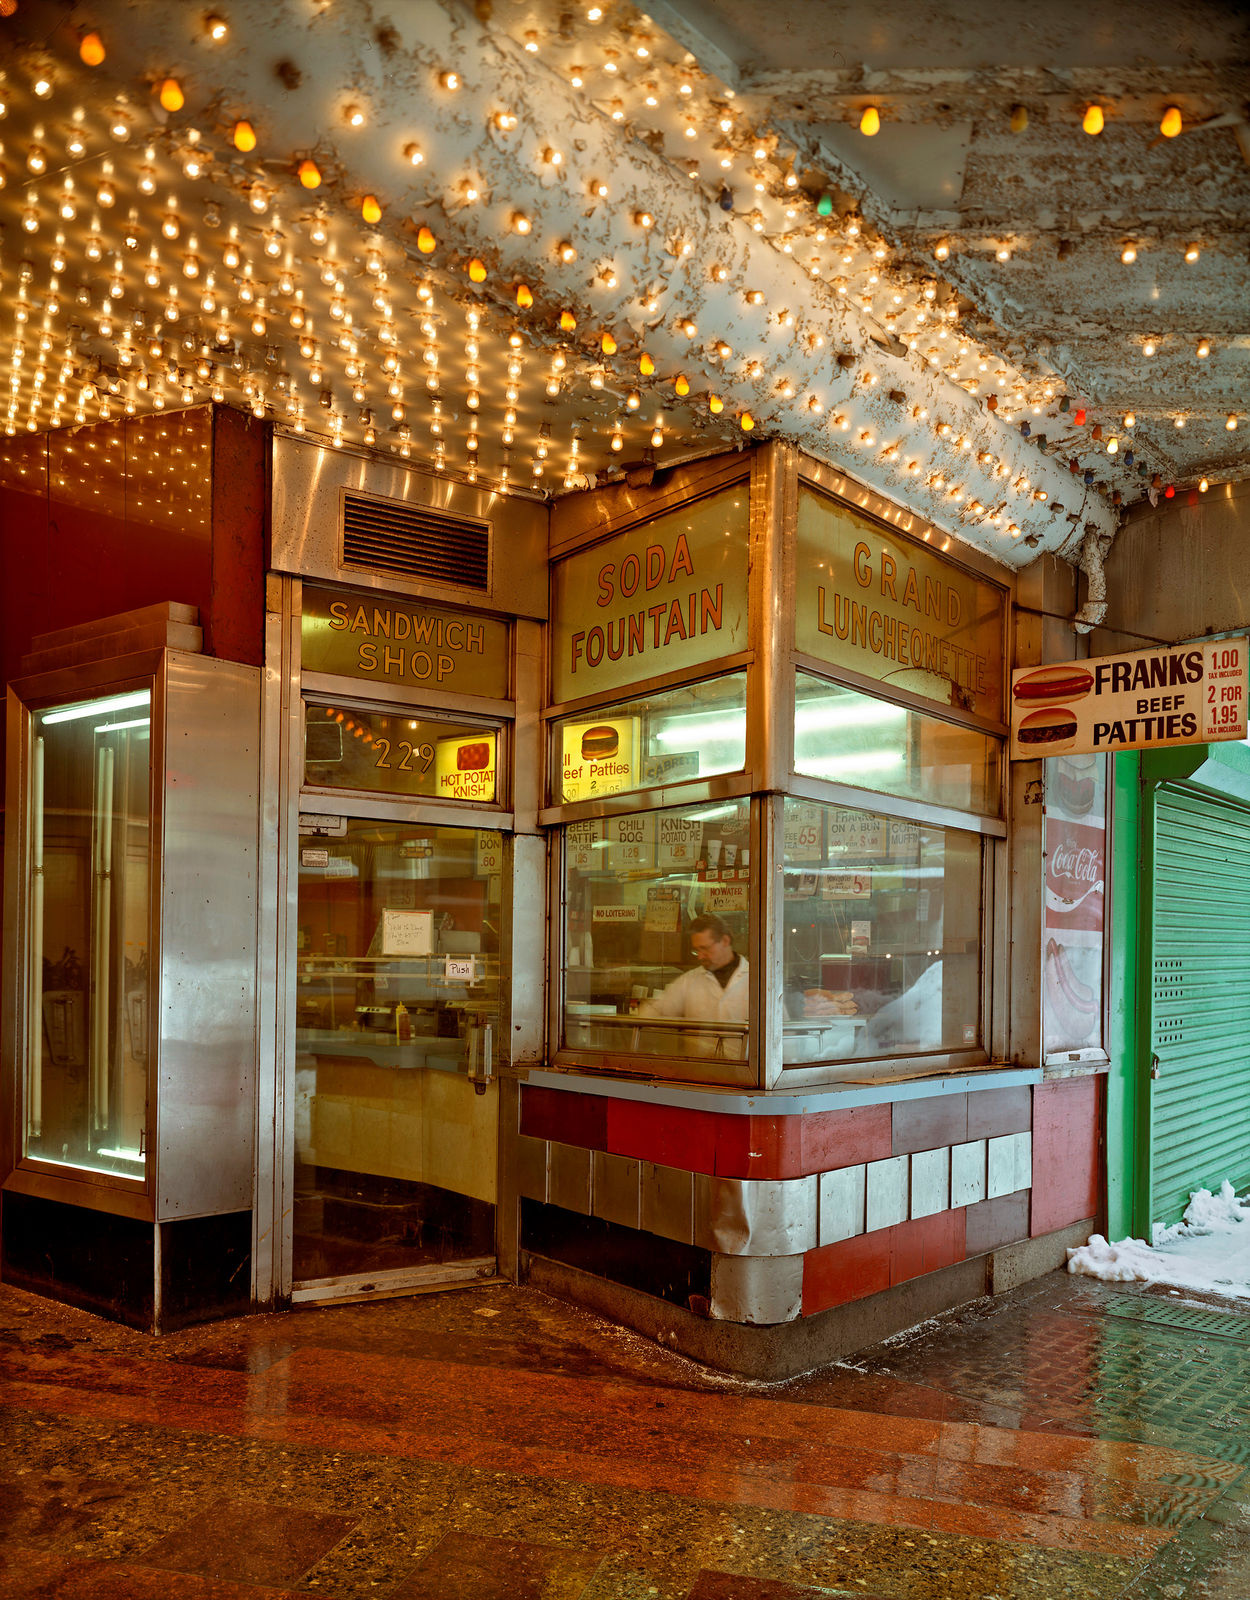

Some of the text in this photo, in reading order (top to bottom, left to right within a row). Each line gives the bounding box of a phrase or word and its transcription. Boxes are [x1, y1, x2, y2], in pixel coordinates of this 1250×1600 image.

[596, 533, 694, 607] SODA
[854, 541, 961, 627] GRAND
[328, 601, 485, 654] SANDWICH
[571, 583, 723, 673] FOUNTAIN
[818, 586, 986, 695] LUNCHEONETTE
[358, 642, 455, 682] SHOP
[1212, 649, 1239, 670] 1.00
[1095, 651, 1203, 695] FRANKS
[1208, 669, 1243, 680] TAX INCLUDED
[1207, 685, 1242, 704] 2 FOR
[1137, 694, 1185, 715] BEEF
[1211, 705, 1238, 726] 1.95
[1093, 712, 1197, 746] PATTIES
[1207, 724, 1242, 734] TAX INCLUDED
[374, 738, 435, 774] 229
[590, 762, 629, 777] Patties
[440, 773, 462, 787] HOT
[453, 784, 486, 798] KNISH
[569, 820, 596, 832] BEEF
[618, 819, 645, 831] CHILI
[661, 817, 701, 831] KNISH
[831, 822, 880, 833] ON A BUN
[619, 831, 644, 843] DOG
[661, 830, 701, 844] POTATO PIE
[1051, 844, 1099, 882] Coca-Cola
[710, 887, 743, 897] NO WATER
[596, 909, 636, 918] NO LOITERING
[449, 963, 470, 974] Push
